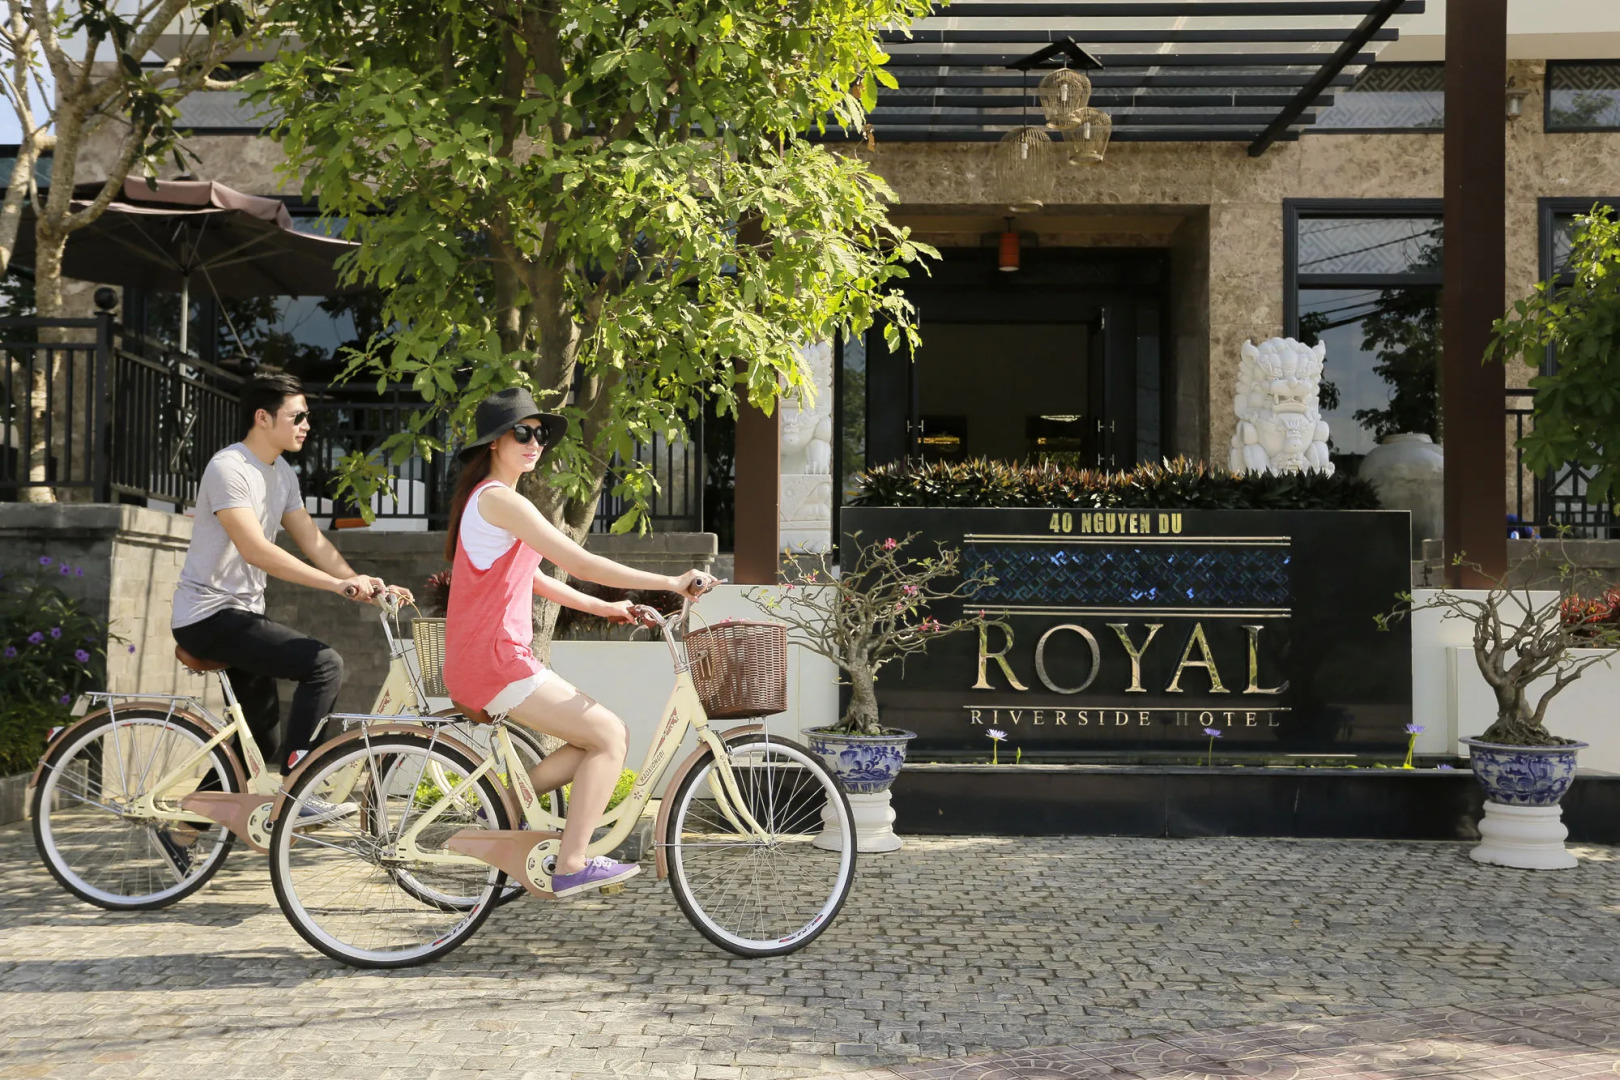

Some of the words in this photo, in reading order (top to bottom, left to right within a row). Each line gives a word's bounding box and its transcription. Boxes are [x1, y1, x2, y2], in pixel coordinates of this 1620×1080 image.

[1049, 512, 1073, 533] 40
[1081, 512, 1151, 534] NGUYEN
[1158, 513, 1182, 534] DU
[971, 621, 1290, 694] ROYAL
[970, 710, 1151, 726] RIVERSIDE
[1176, 711, 1280, 727] HOTEL
